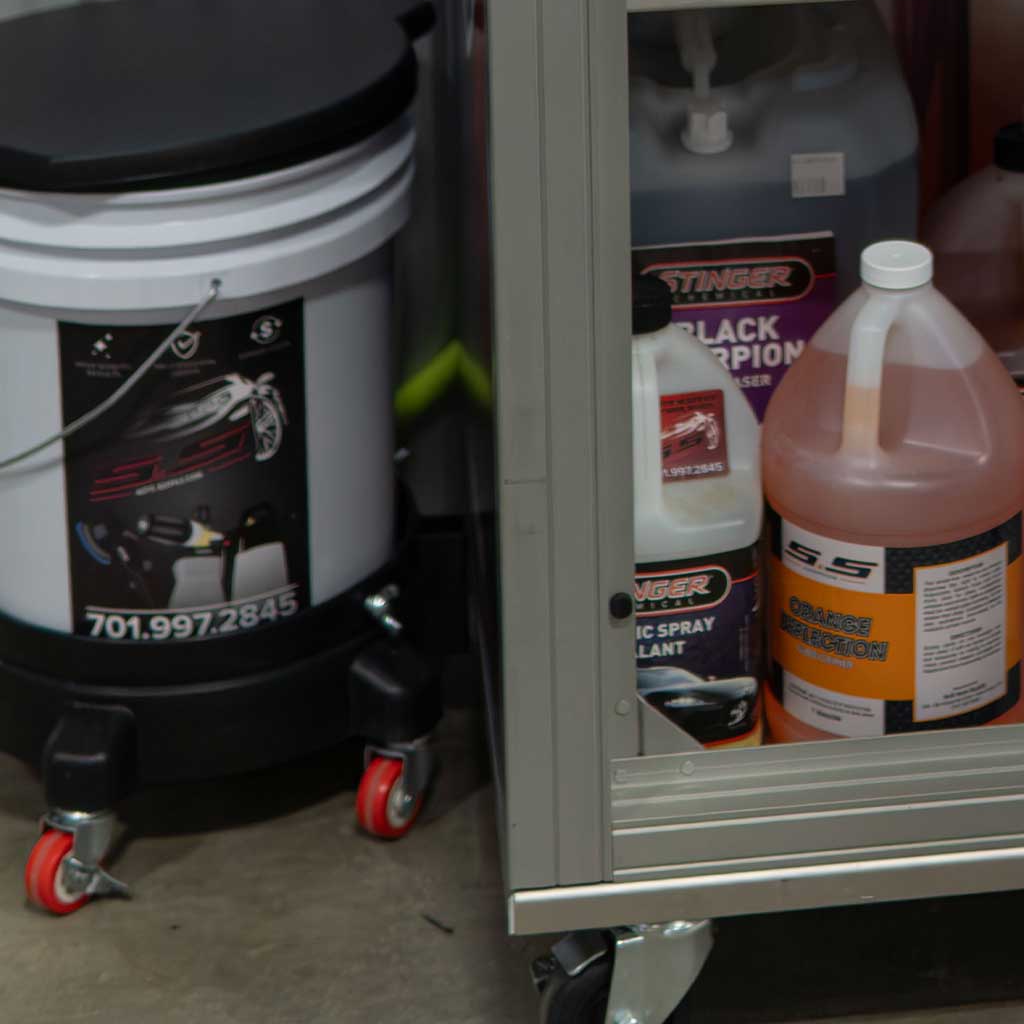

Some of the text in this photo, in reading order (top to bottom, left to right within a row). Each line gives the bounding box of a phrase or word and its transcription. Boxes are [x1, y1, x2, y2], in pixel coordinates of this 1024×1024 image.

[713, 339, 805, 370] RPION
[635, 574, 712, 602] NGER
[86, 591, 299, 641] 701.997.2845
[657, 616, 716, 638] SPRAY
[789, 595, 873, 638] ORANGE
[637, 640, 687, 659] LANT
